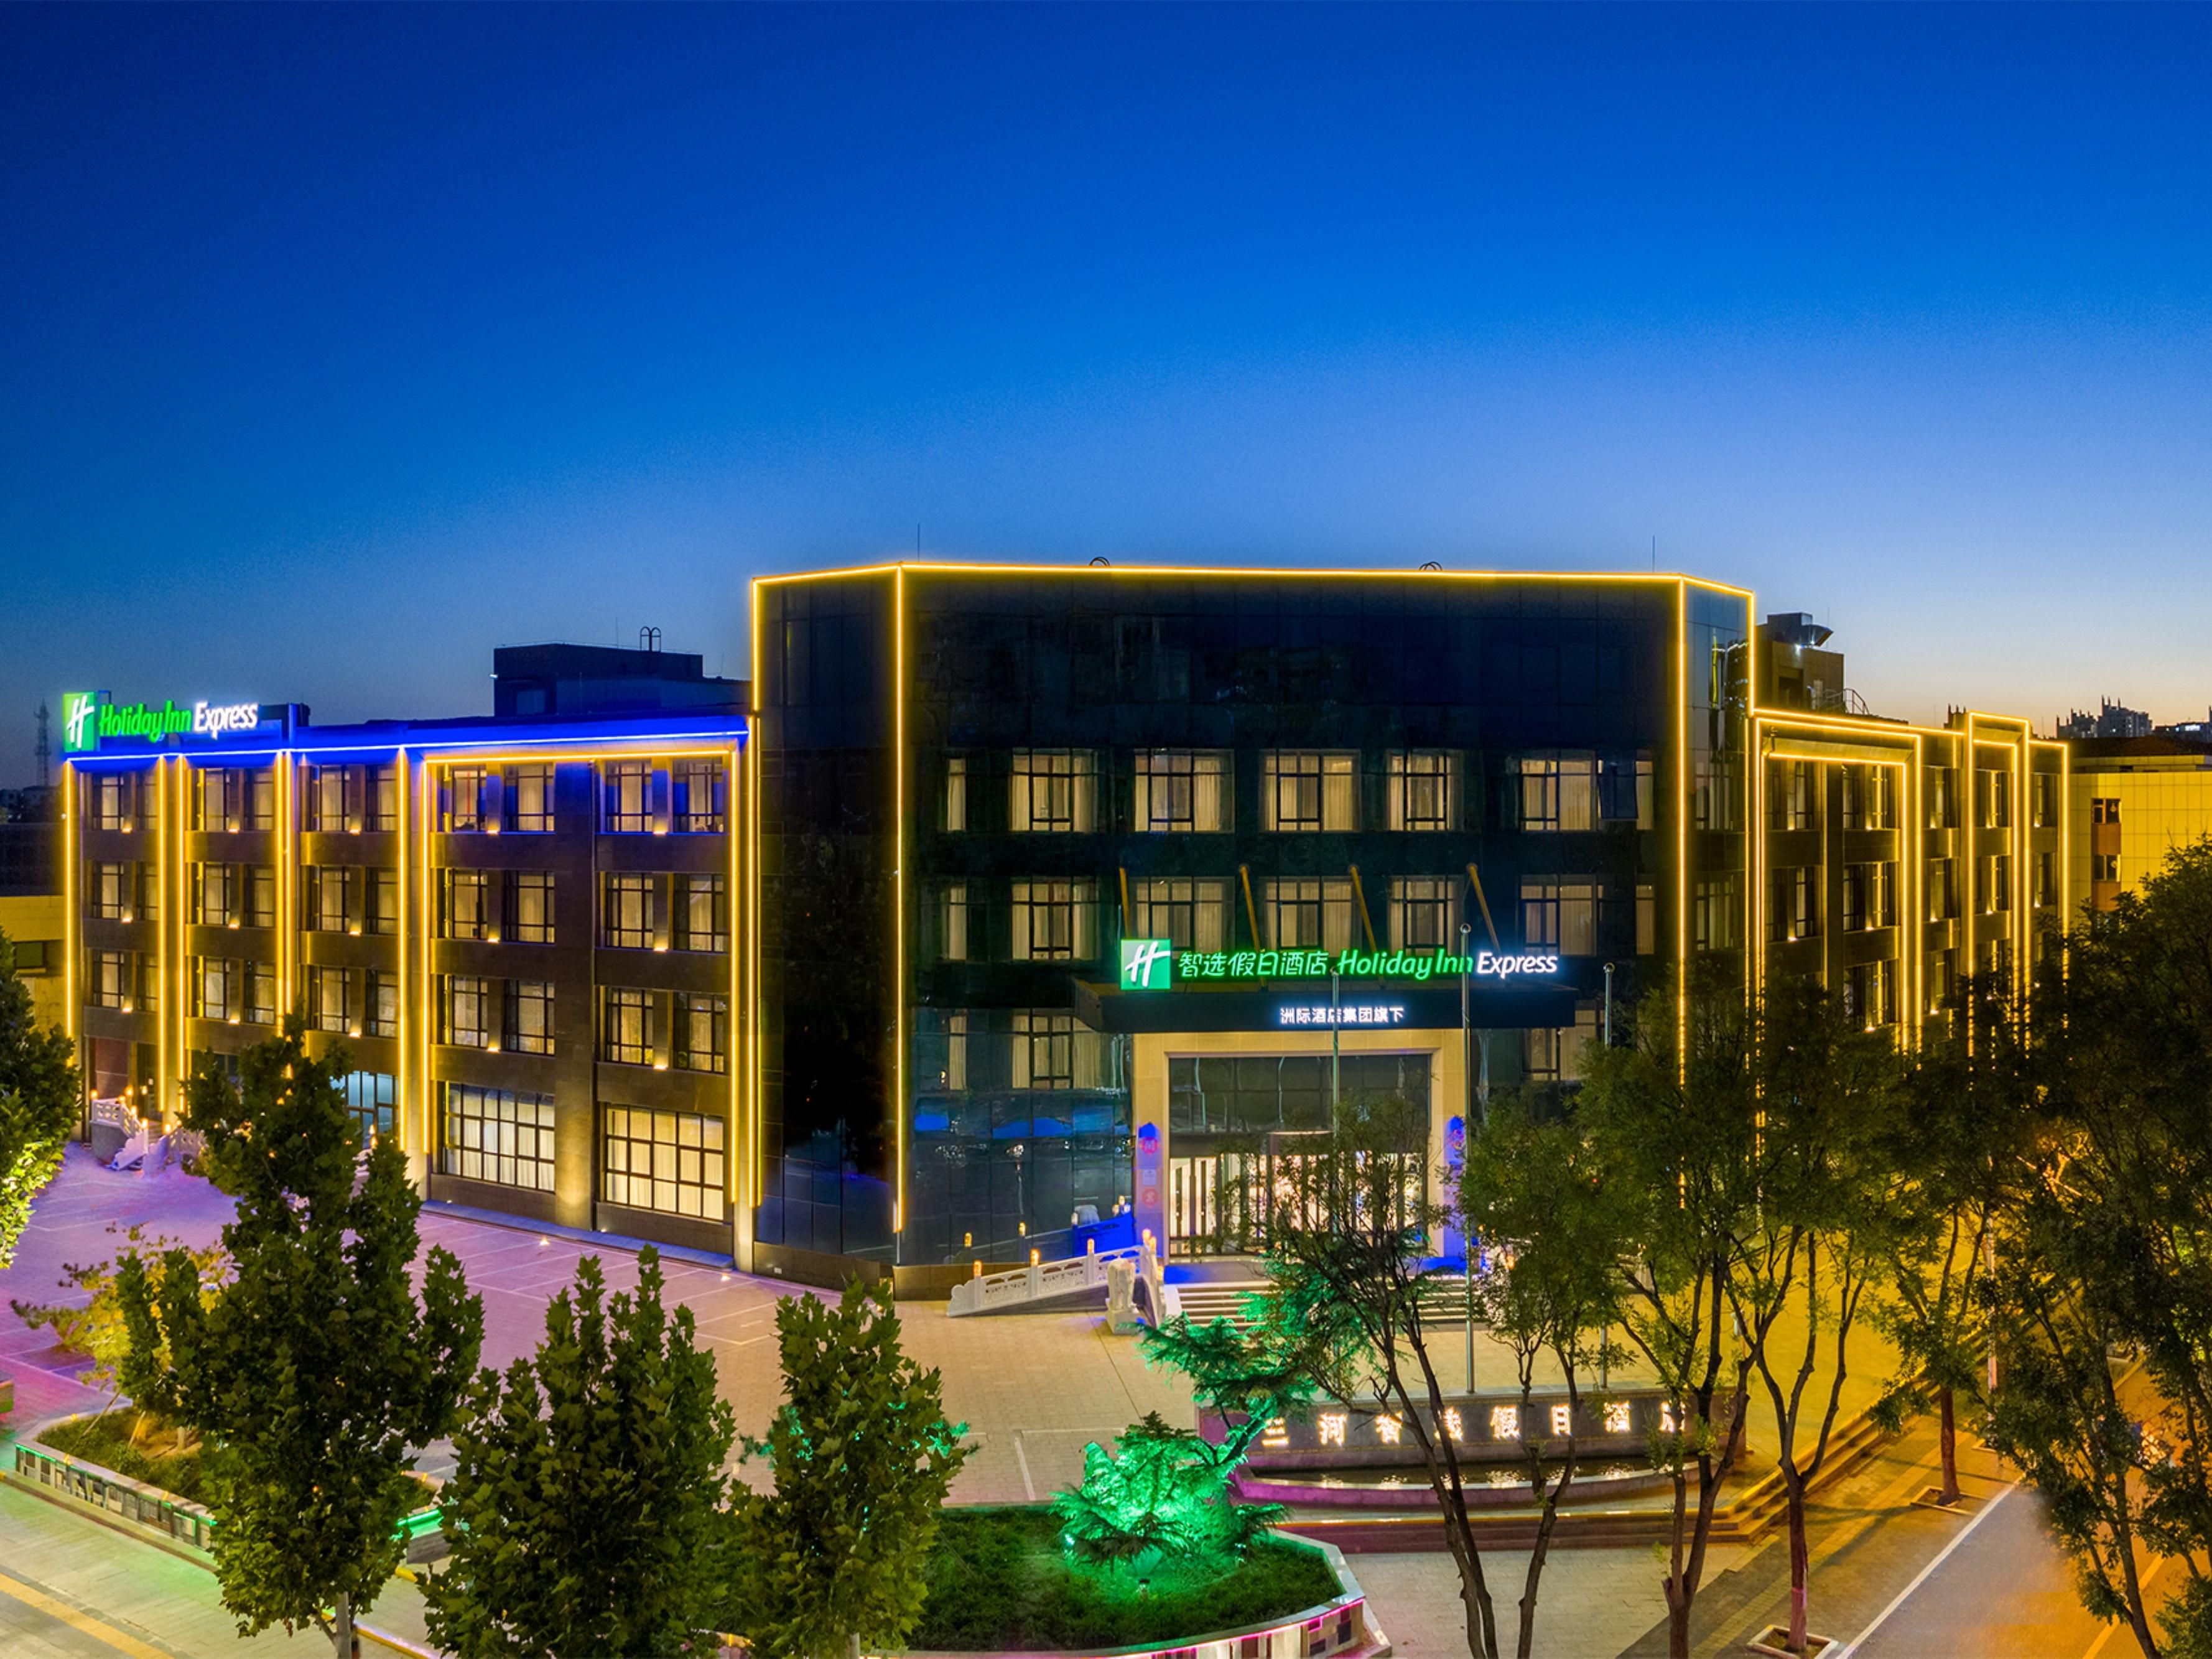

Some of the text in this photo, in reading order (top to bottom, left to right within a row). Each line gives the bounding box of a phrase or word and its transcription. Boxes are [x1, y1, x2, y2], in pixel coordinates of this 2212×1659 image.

[98, 703, 163, 743] Holiday
[164, 700, 191, 733] Inn
[193, 701, 258, 740] Express
[1179, 951, 1329, 977] 智选假日酒店
[1338, 948, 1558, 980] Holiday Inn Express
[1280, 1006, 1404, 1024] 洲际酒店集团旗下
